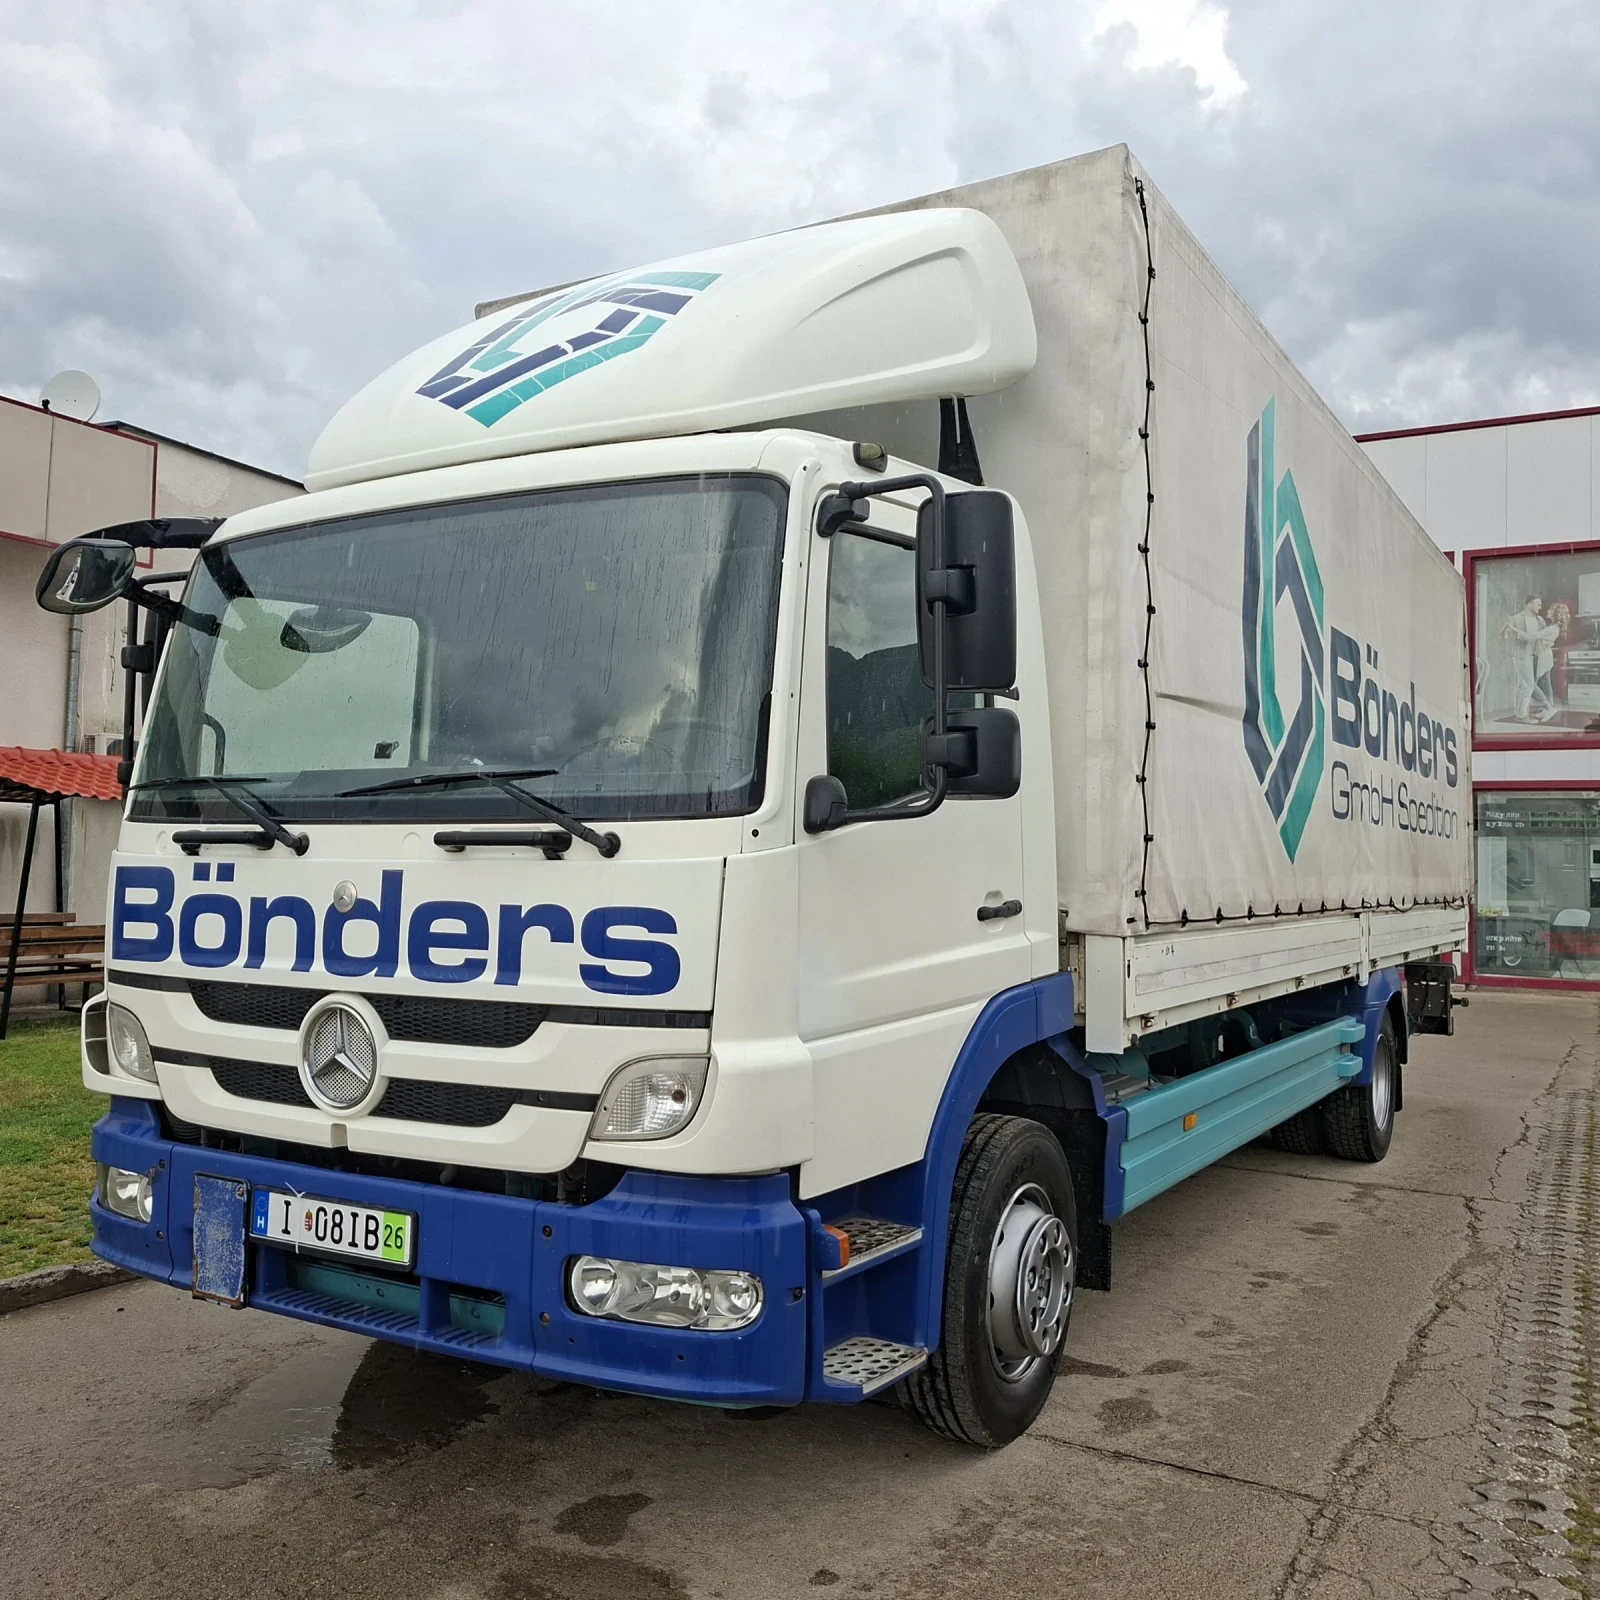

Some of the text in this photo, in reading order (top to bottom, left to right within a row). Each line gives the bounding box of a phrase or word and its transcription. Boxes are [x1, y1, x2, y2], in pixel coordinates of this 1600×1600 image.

[1330, 625, 1458, 788] Bönders
[1331, 760, 1459, 840] GmbH Spedition
[1485, 821, 1513, 829] кухни
[112, 862, 681, 996] Bönders
[256, 1216, 264, 1230] H
[383, 1223, 404, 1250] 26
